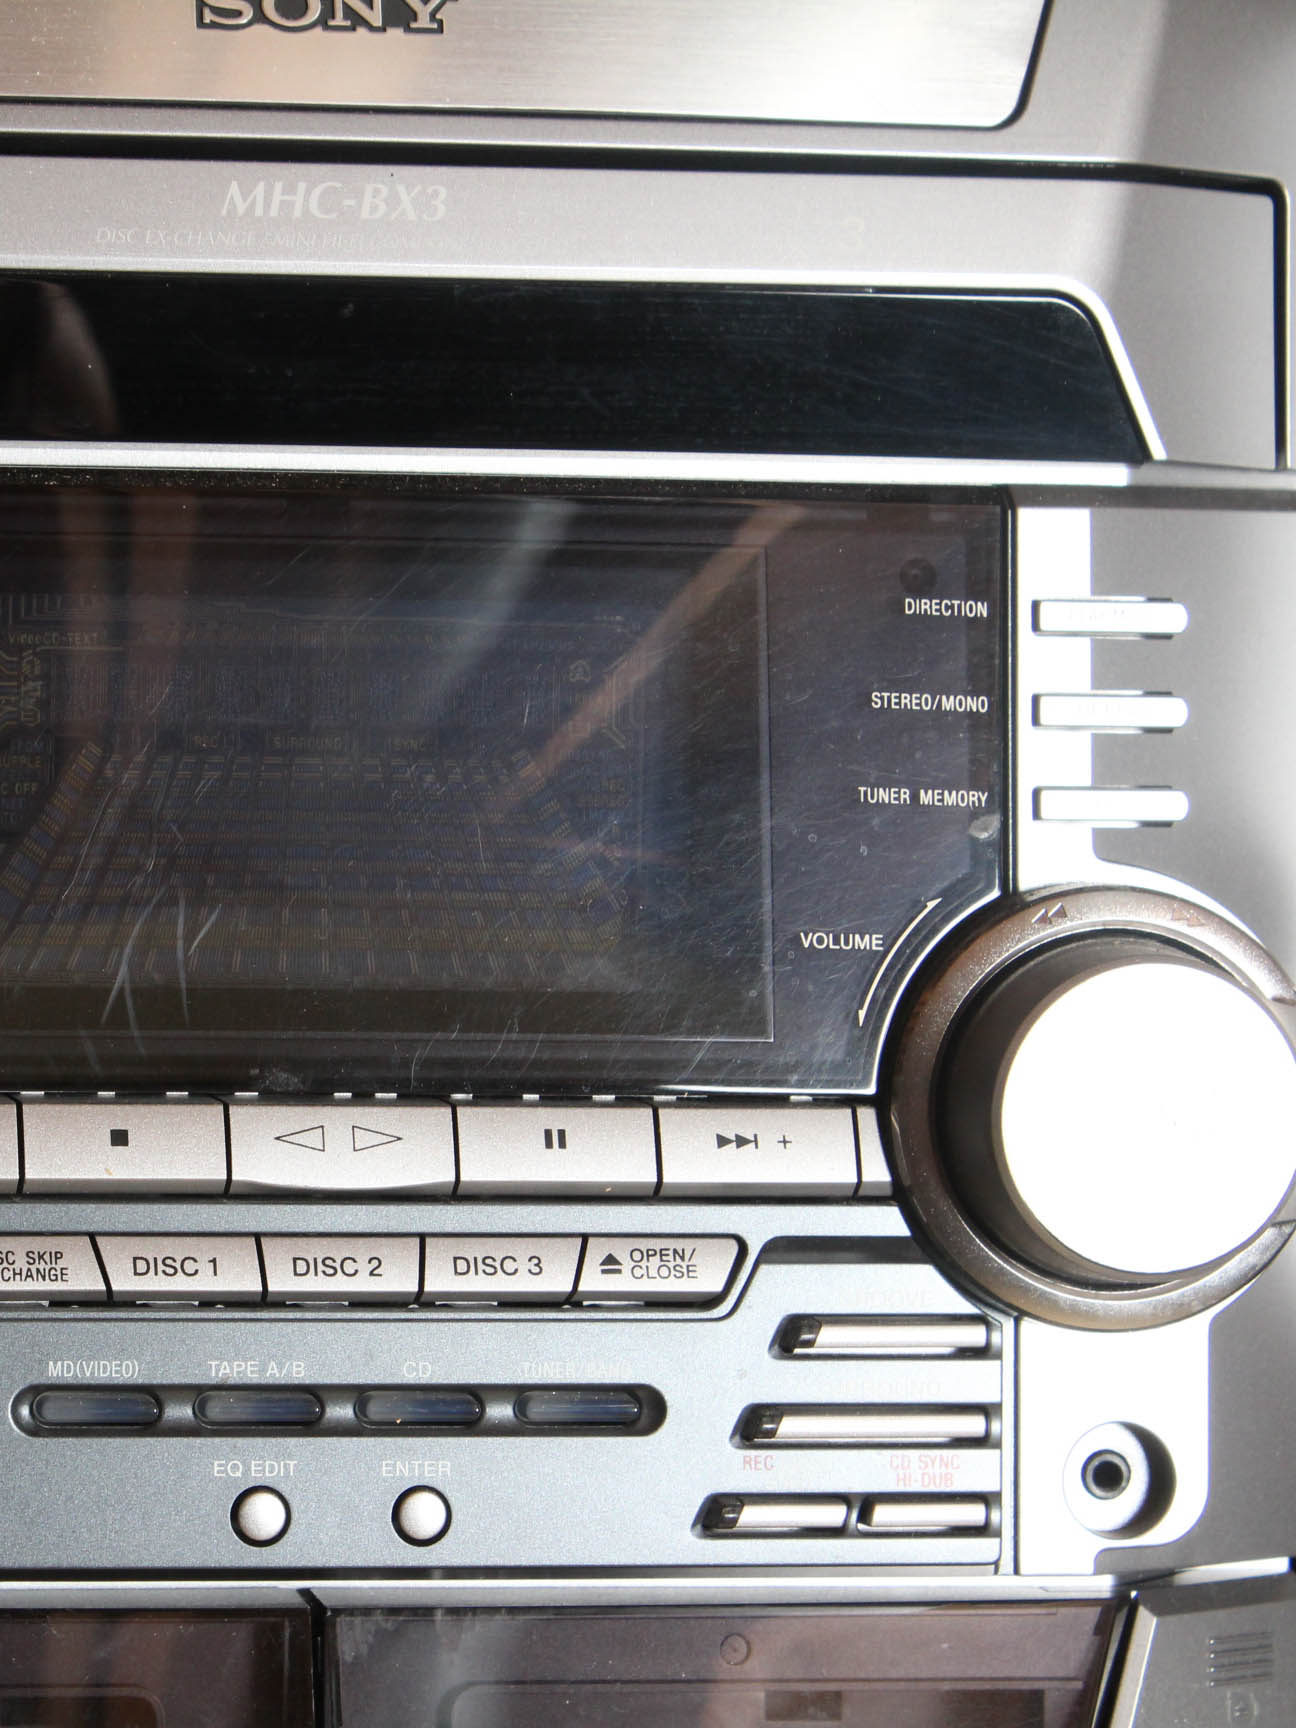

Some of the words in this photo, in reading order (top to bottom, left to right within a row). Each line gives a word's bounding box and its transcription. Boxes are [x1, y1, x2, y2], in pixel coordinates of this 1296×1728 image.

[197, 0, 444, 32] SONY
[220, 180, 448, 221] MHC-BX3
[96, 227, 138, 244] DISC
[905, 598, 988, 618] DIRECTION
[871, 692, 989, 713] STEREO/MONO
[858, 787, 910, 805] TUNER
[920, 789, 988, 808] MEMORY
[800, 931, 884, 951] VOLUME
[25, 1250, 64, 1268] SKIP
[630, 1247, 697, 1263] OPEN/
[131, 1256, 200, 1277] DISC
[208, 1256, 219, 1277] 1
[292, 1256, 359, 1277] DISC
[369, 1256, 383, 1277] 2
[452, 1255, 519, 1276] DISC
[529, 1255, 543, 1276] 3
[630, 1262, 698, 1280] CLOSE
[48, 1360, 139, 1380] MD(VIDEO)
[208, 1361, 260, 1379] TAPE
[267, 1360, 306, 1379] A/B
[403, 1361, 432, 1379] CD
[213, 1460, 244, 1479] EQ
[252, 1460, 297, 1477] EDIT
[381, 1460, 452, 1478] ENTER
[742, 1454, 775, 1471] REC
[889, 1455, 911, 1470] CD
[918, 1455, 961, 1470] SYNC
[896, 1472, 954, 1488] HI-DUB
